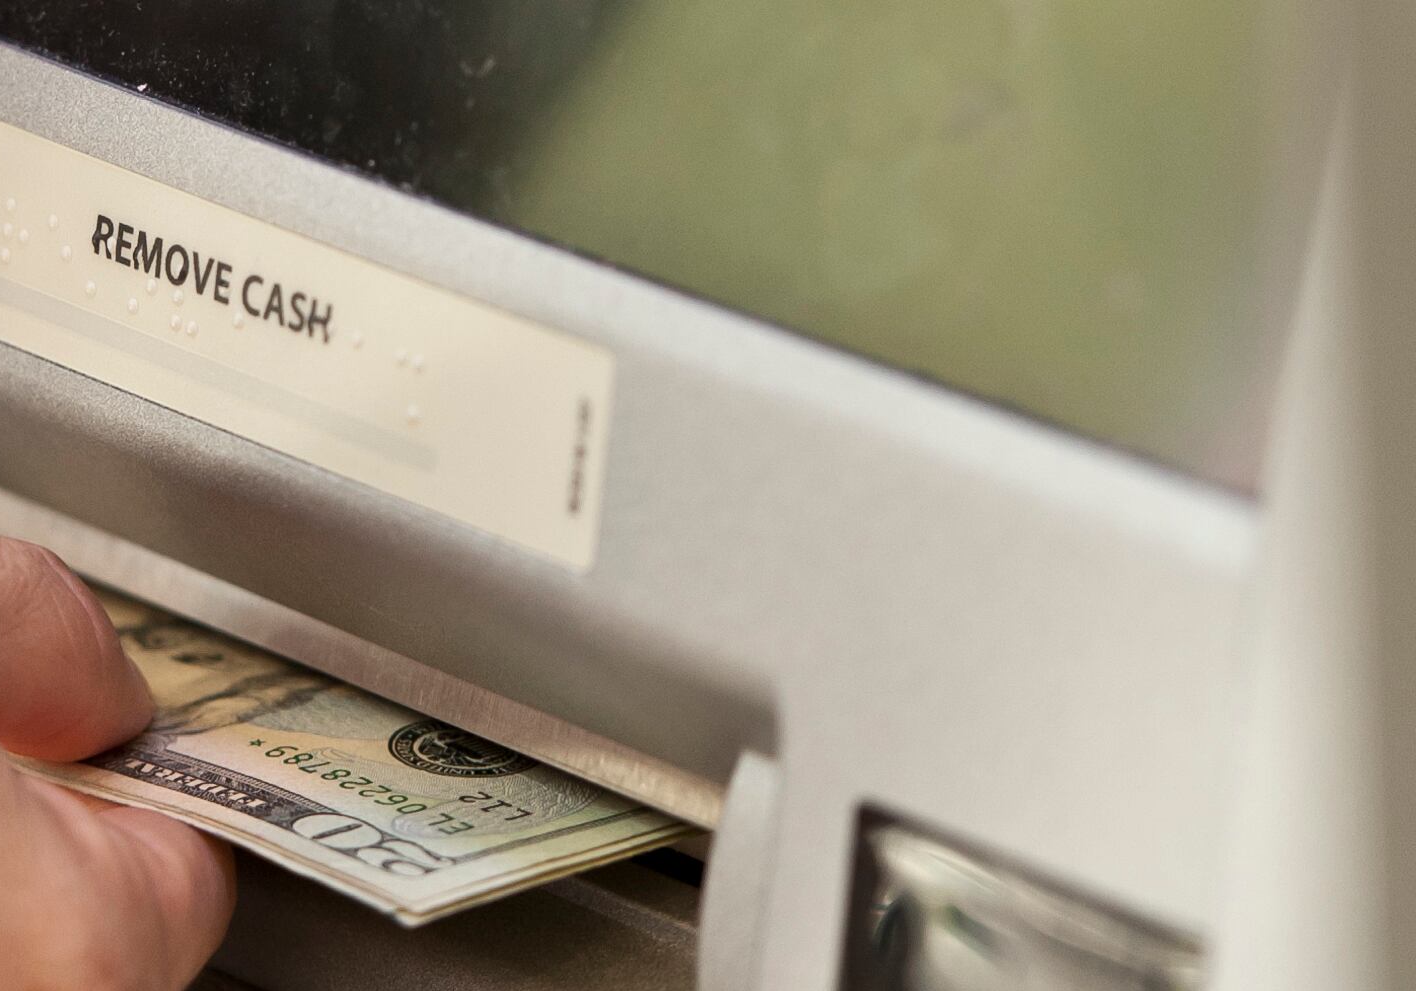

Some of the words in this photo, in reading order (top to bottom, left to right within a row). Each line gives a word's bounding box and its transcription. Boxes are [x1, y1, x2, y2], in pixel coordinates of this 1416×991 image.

[91, 213, 232, 306] REMOVE
[240, 273, 334, 344] CASH
[124, 758, 266, 809] FEDERAL
[458, 790, 532, 824] L12
[291, 813, 455, 875] 20
[423, 811, 475, 835] EL
